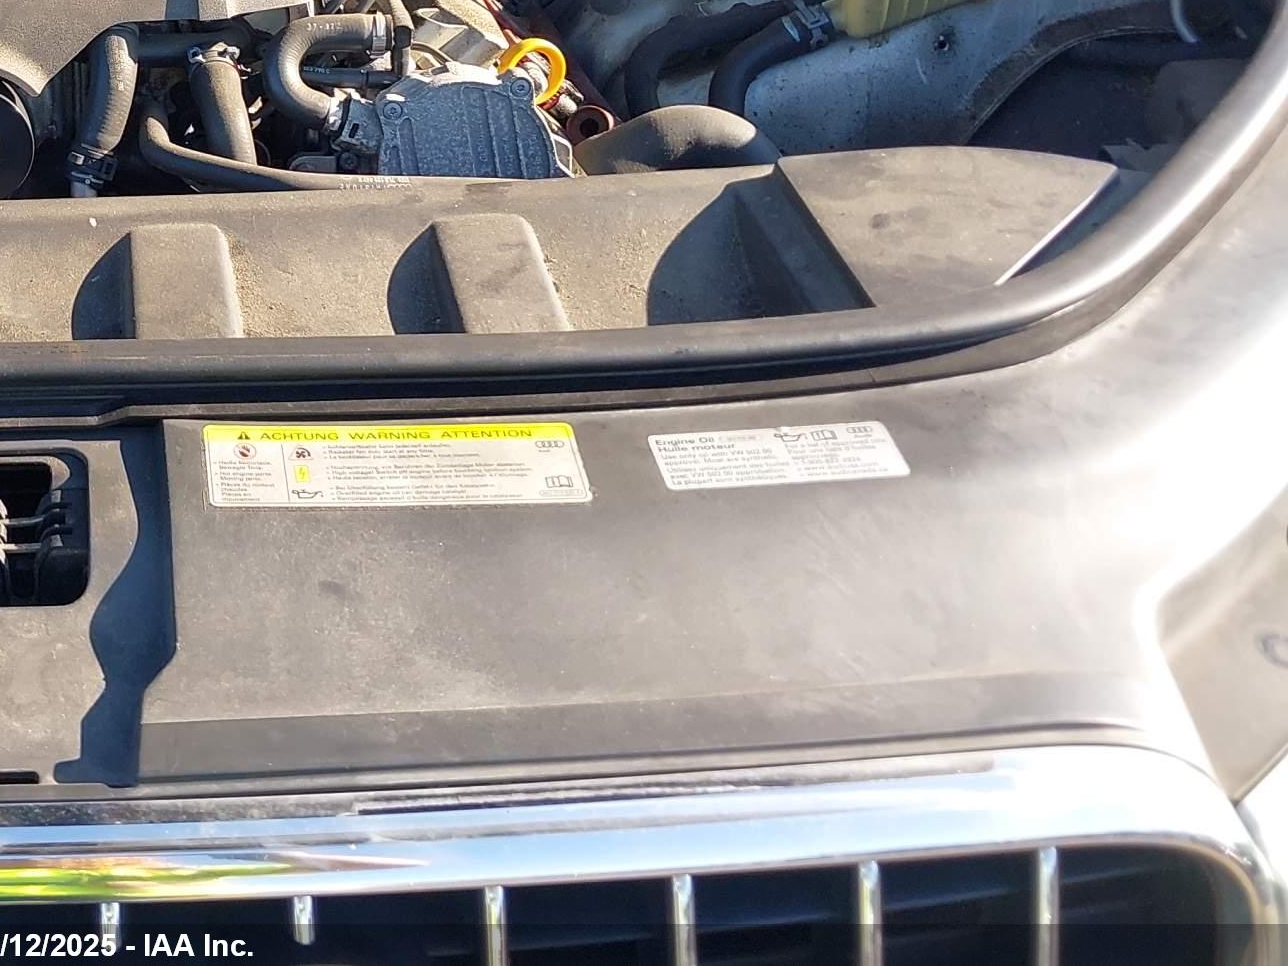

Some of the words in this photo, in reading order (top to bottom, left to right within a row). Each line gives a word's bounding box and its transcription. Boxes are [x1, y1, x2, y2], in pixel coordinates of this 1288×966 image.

[260, 432, 339, 441] ACHTUNG
[348, 431, 431, 440] WARNING
[440, 429, 533, 439] ATTENTION
[655, 438, 696, 446] Engine
[658, 445, 688, 453] Huile
